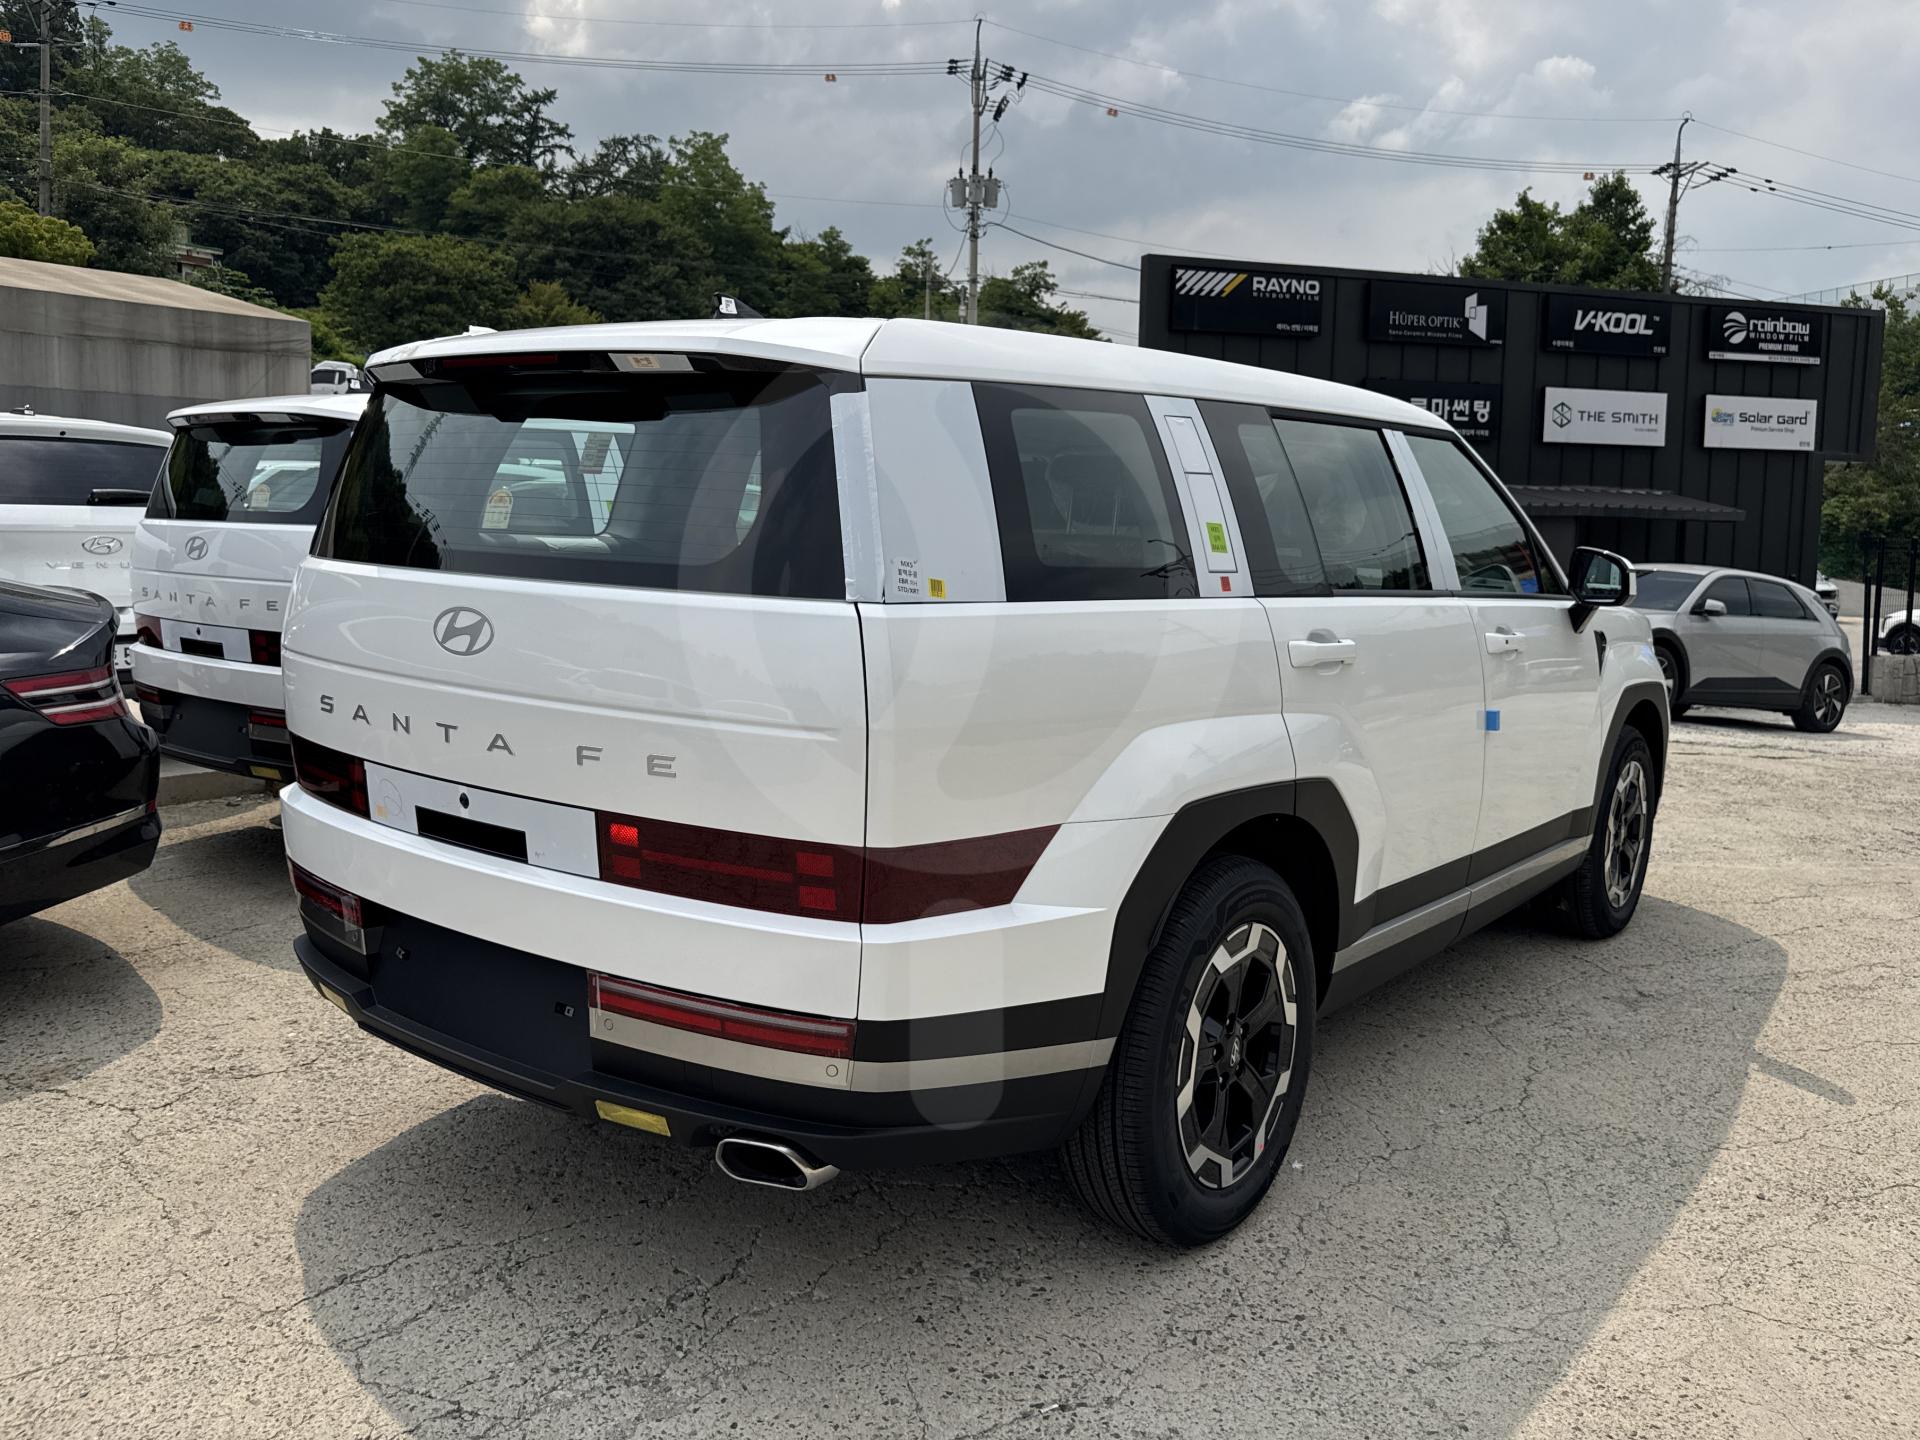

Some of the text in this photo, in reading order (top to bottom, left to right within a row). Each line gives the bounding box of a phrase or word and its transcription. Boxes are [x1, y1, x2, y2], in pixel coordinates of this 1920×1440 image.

[1252, 276, 1320, 294] RAYNO
[1428, 315, 1461, 328] OPTIK
[1749, 316, 1810, 334] rainbow
[1749, 333, 1785, 341] WINDOW
[1758, 342, 1799, 352] PREMIUM STORE
[1577, 410, 1659, 425] THE SMITH
[1739, 411, 1808, 425] Solar Gard
[141, 586, 279, 613] SANTA FE
[319, 694, 678, 779] SANTA FE
